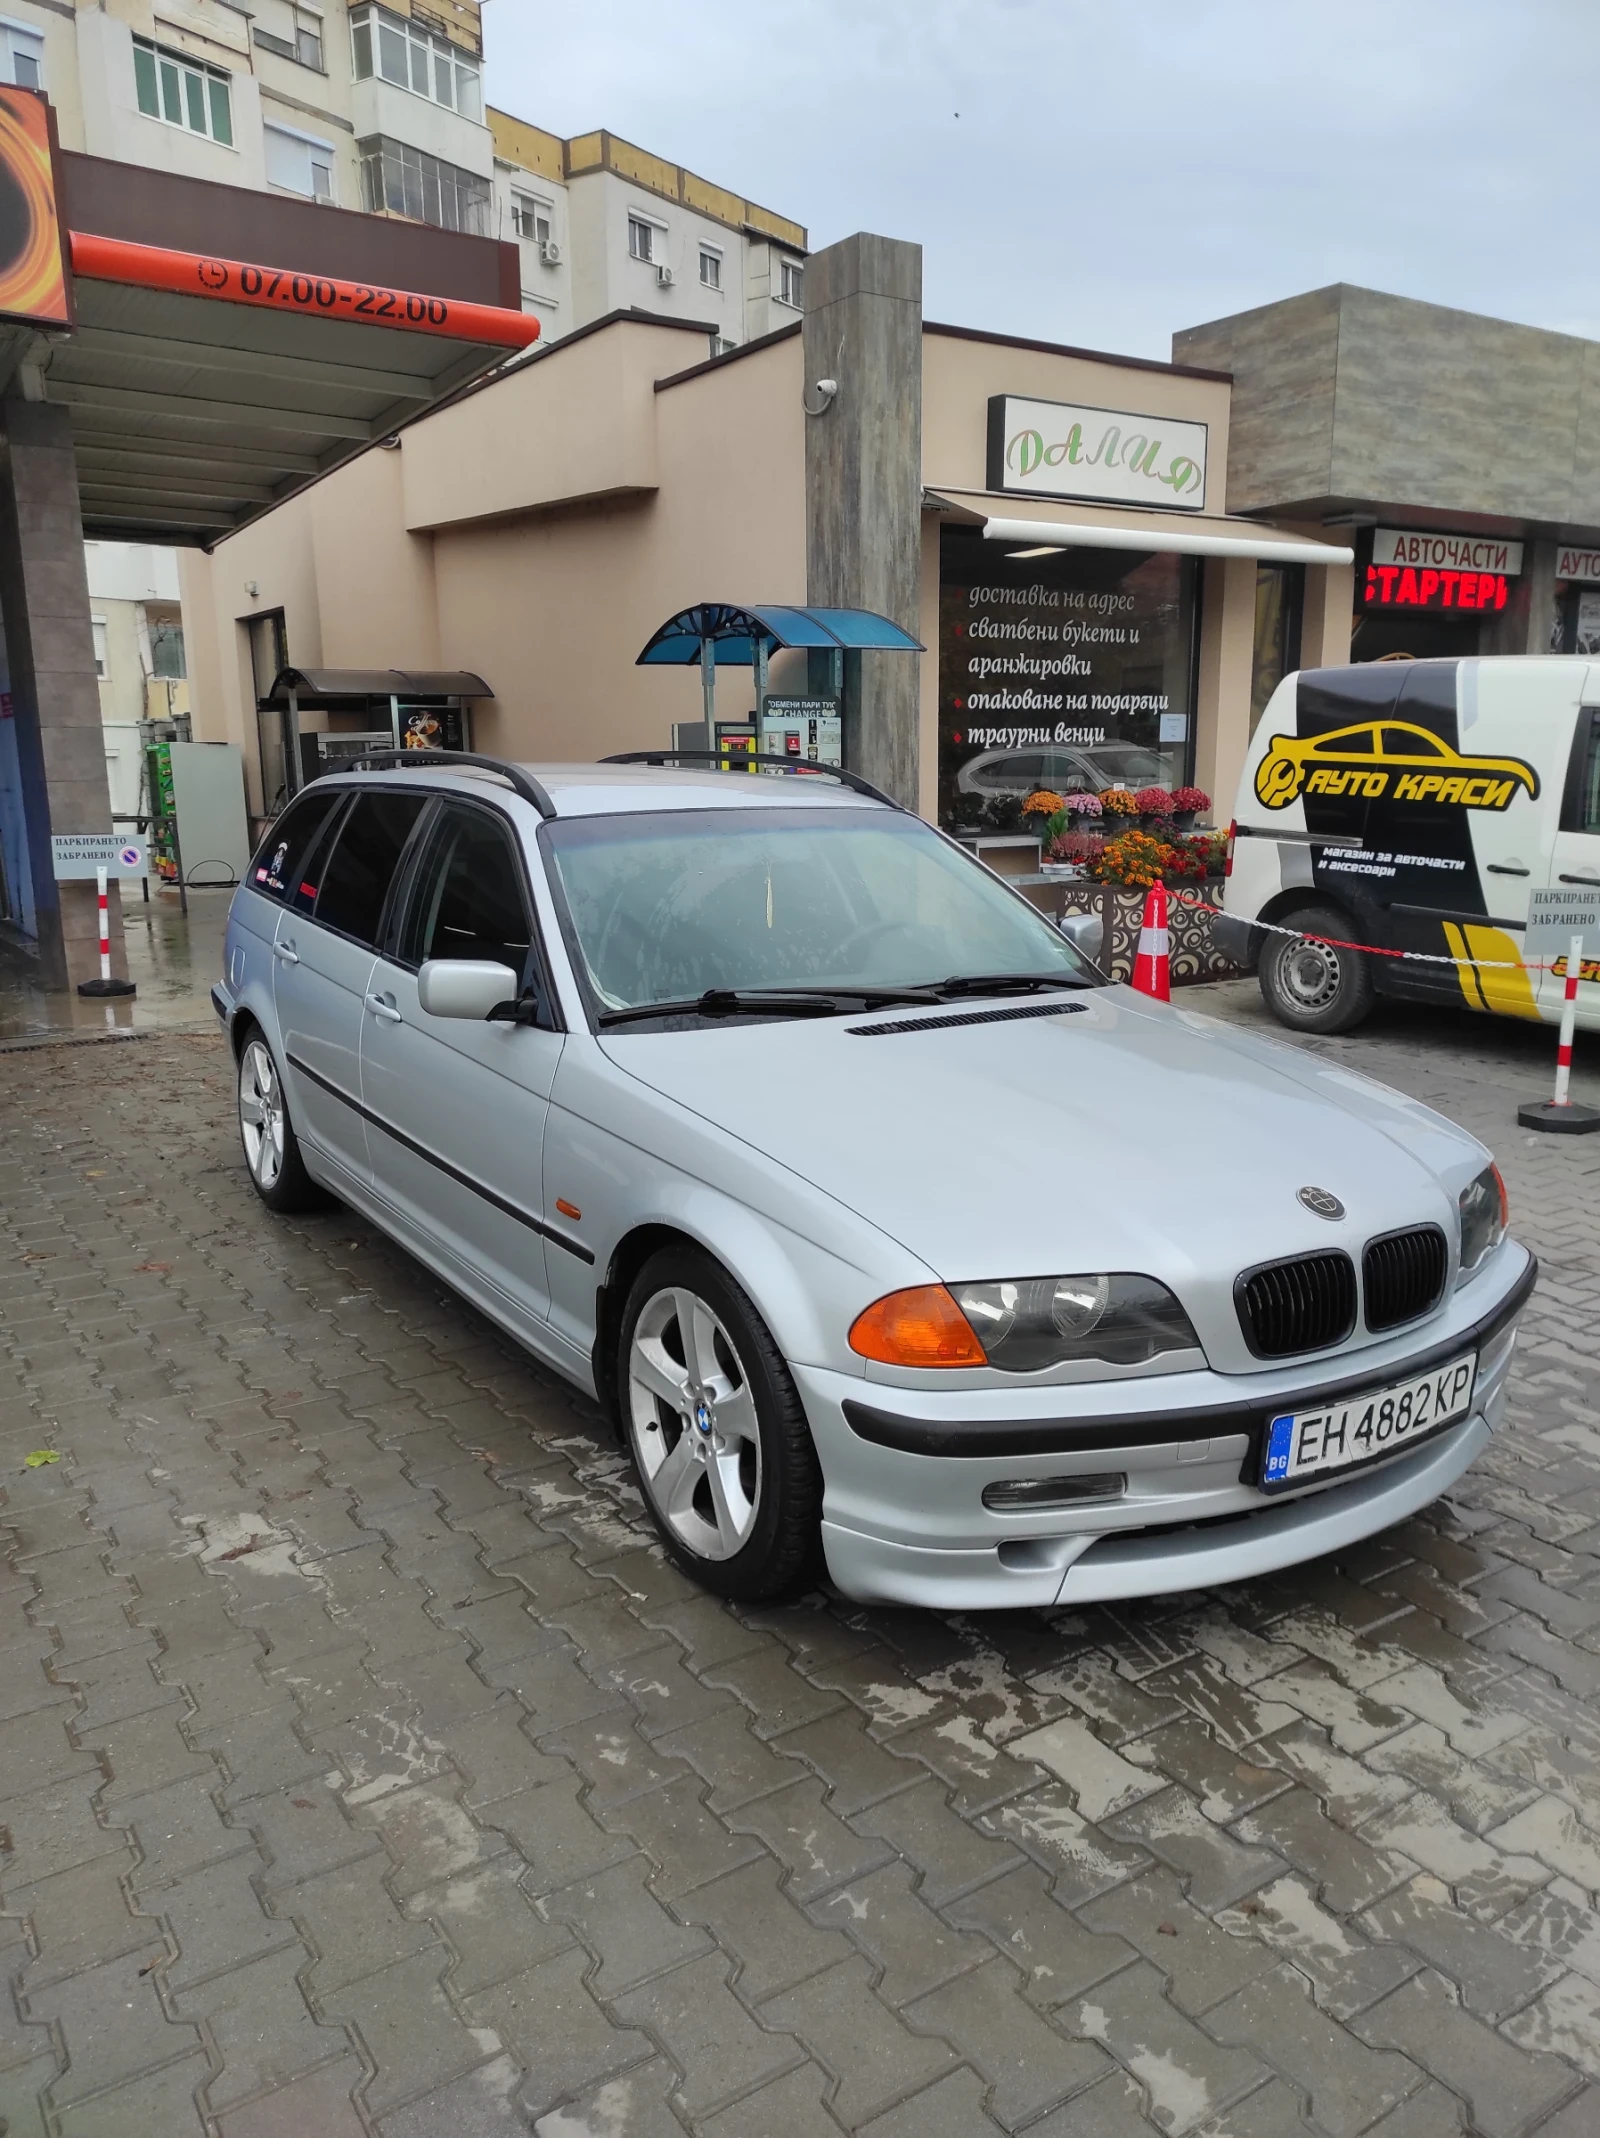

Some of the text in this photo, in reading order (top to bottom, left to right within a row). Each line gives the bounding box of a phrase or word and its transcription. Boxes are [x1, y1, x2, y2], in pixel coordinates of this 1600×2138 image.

[241, 266, 448, 325] 07.00-22.00
[1393, 536, 1507, 569] АВТОЧАСТИ
[969, 584, 1135, 615] доставка на адрес
[968, 616, 1140, 647] сватбени букети и
[968, 653, 1092, 680] аранжировки
[802, 701, 820, 709] ПАРИ
[967, 688, 1169, 715] опаковане на подаръци
[784, 709, 821, 719] CHANGE
[968, 722, 1105, 748] траурни венци
[1306, 769, 1515, 807] АУТО КРАСИ
[56, 837, 127, 846] ПАРКИРАНЕТО
[56, 851, 114, 860] ЗАБРАНЕНО
[1323, 847, 1466, 870] магазин за авточасти
[1318, 860, 1396, 877] и аксесоари
[1531, 914, 1596, 925] ЗАБРАНЕНО
[1269, 1455, 1287, 1471] BG
